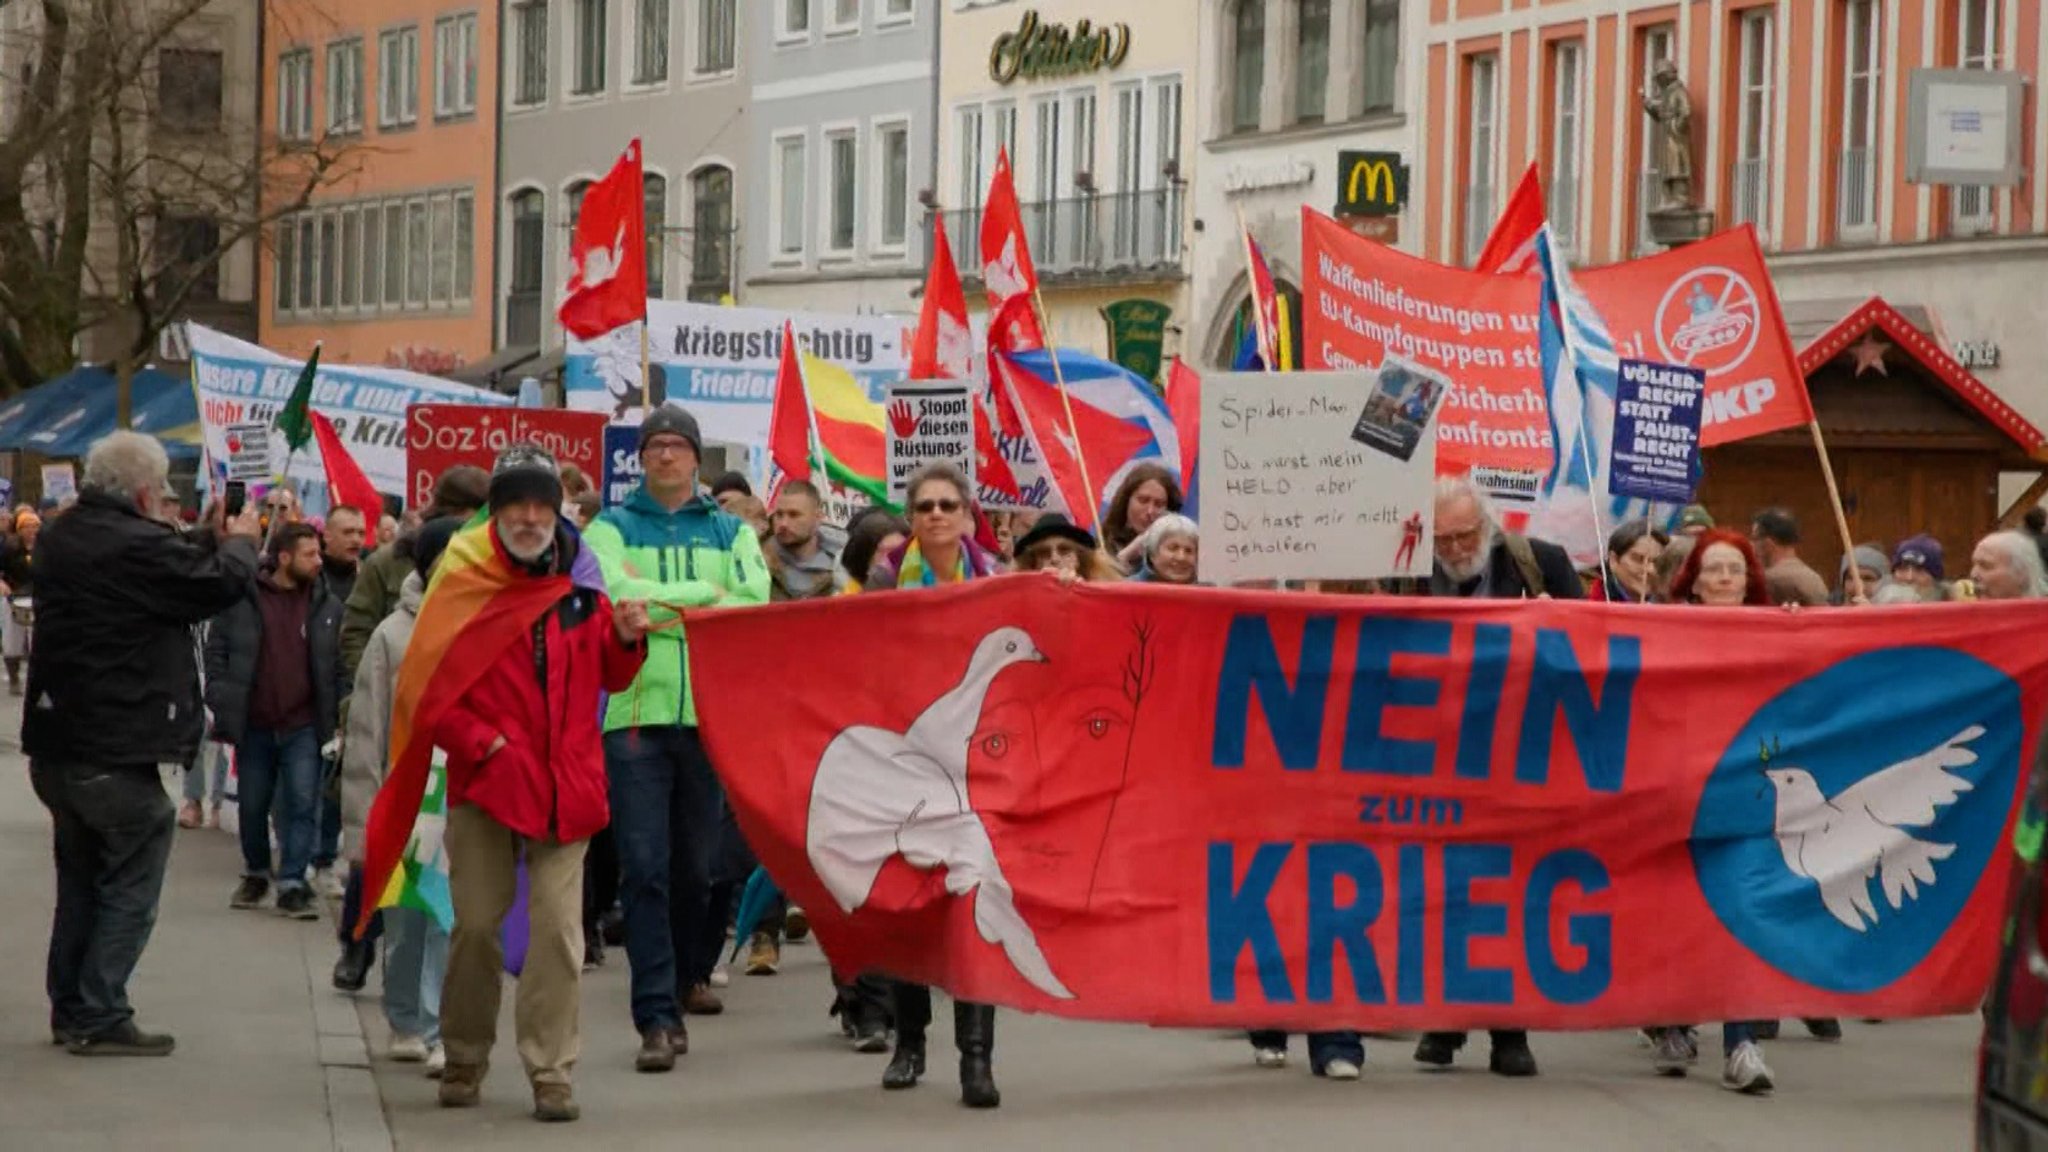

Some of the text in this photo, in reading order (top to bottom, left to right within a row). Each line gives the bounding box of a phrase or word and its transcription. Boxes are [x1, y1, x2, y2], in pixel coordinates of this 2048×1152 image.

[1319, 251, 1504, 335] Waffenlieferungen
[1320, 291, 1505, 368] EU-Kampfgruppen
[1623, 364, 1704, 390] VÖLKER-
[919, 399, 967, 416] Stoppt
[1447, 383, 1544, 413] Sicherh
[1638, 385, 1697, 409] RECHT
[1620, 400, 1672, 422] STATT
[410, 408, 592, 462] Sozialismus
[919, 419, 969, 437] diesen
[1439, 420, 1554, 448] onfronta
[1634, 420, 1697, 442] FAUST-
[893, 440, 969, 458] Rüstungs-
[1223, 449, 1251, 471] Du
[1319, 450, 1363, 468] mein
[1633, 437, 1691, 460] RECHT
[1315, 475, 1356, 496] aber
[1262, 508, 1304, 529] hast
[1314, 508, 1345, 526] mir
[1357, 505, 1399, 525] nicht
[1225, 535, 1318, 563] geholfen
[1211, 613, 1641, 793] NEIN
[1358, 795, 1463, 825] zum
[1207, 841, 1613, 1005] KRIEG
